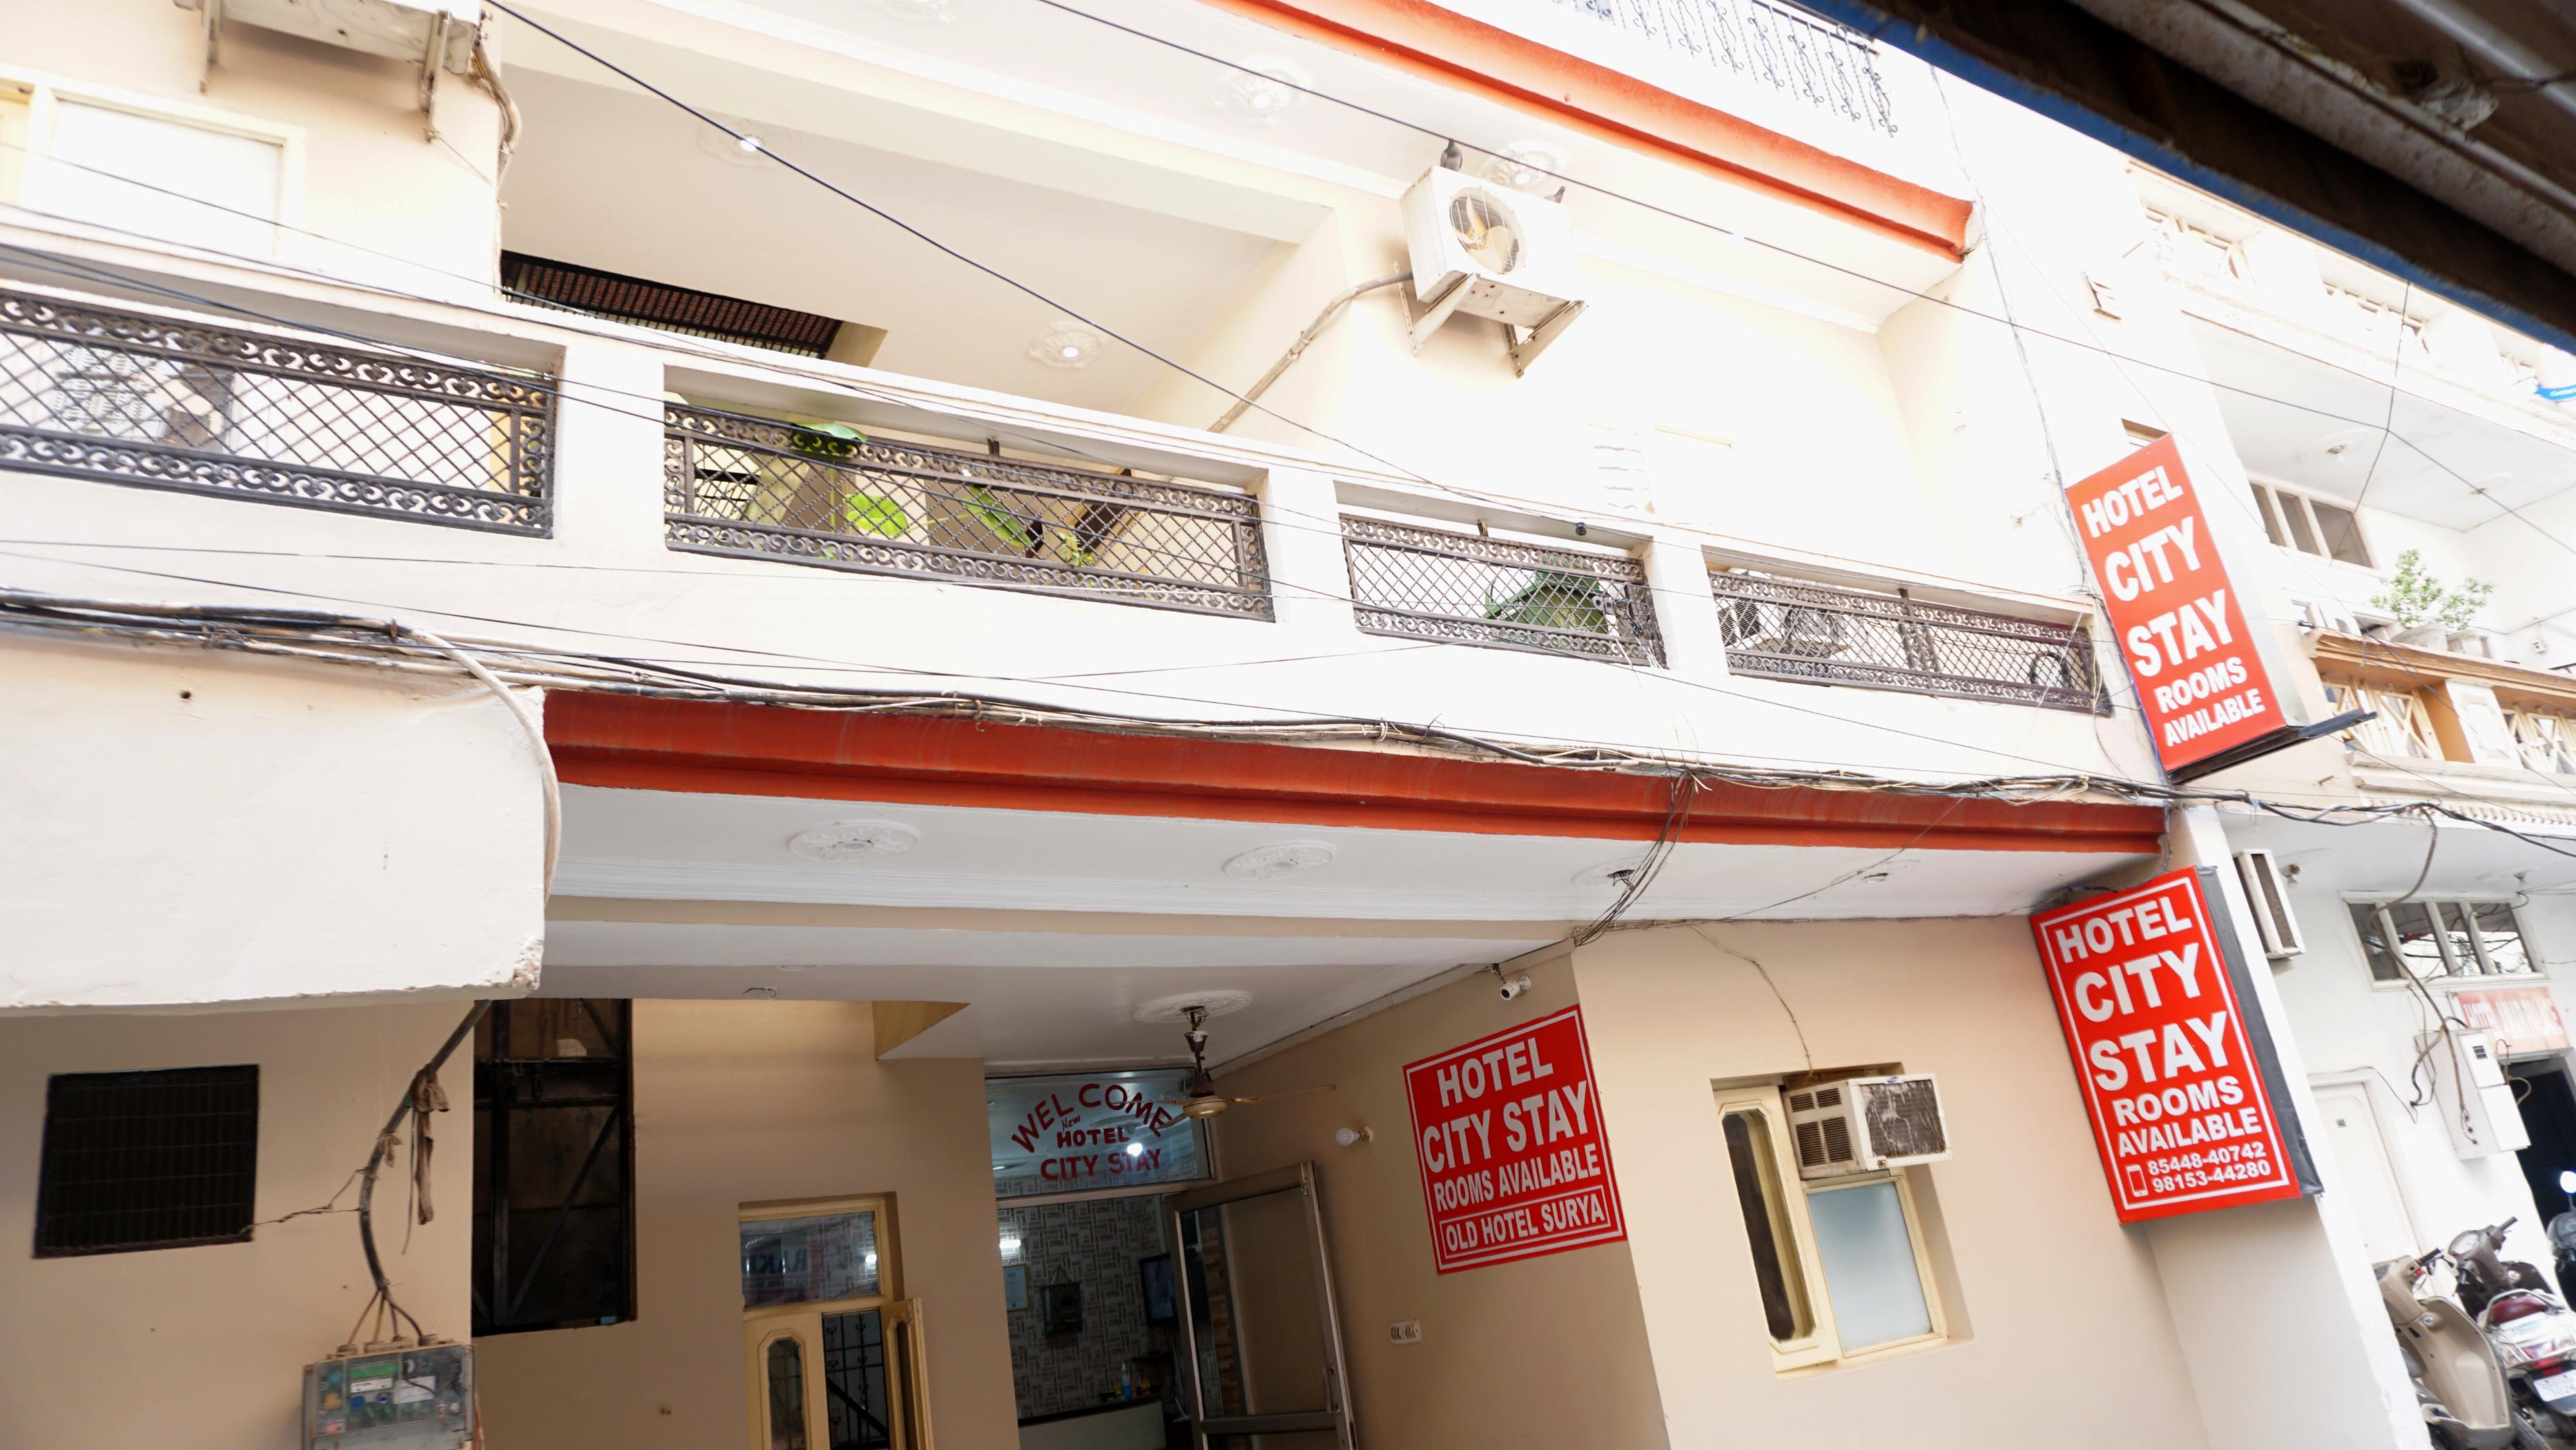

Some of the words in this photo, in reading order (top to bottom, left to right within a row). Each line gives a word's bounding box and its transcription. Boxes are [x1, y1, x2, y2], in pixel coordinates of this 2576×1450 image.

[2080, 465, 2184, 539] HOTEL
[2104, 516, 2201, 602] CITY
[2127, 588, 2234, 677] STAY
[2153, 657, 2248, 713] ROOMS
[2163, 688, 2266, 747] AVAILABLE
[2055, 896, 2193, 964] HOTEL
[2074, 942, 2201, 1023] CITY
[1436, 1037, 1554, 1108] HOTEL
[2089, 1011, 2229, 1092] STAY
[1011, 1083, 1172, 1153] WELCOME
[1422, 1109, 1491, 1174] CITY
[1502, 1080, 1589, 1152] STAY
[2111, 1076, 2245, 1127] ROOMS
[2118, 1108, 2263, 1159] AVAILABLE
[1040, 1154, 1099, 1181] CITY
[1107, 1148, 1161, 1174] STAY
[1056, 1126, 1130, 1149] HOTEL
[2147, 1141, 2267, 1176] 85448-40742
[1433, 1170, 1494, 1212] ROOMS
[1498, 1143, 1601, 1198] AVAILABLE
[2152, 1159, 2272, 1194] 98153-44280
[1444, 1220, 1478, 1253] OLD
[1481, 1208, 1539, 1245] HOTEL
[1540, 1193, 1606, 1232] SURYA
